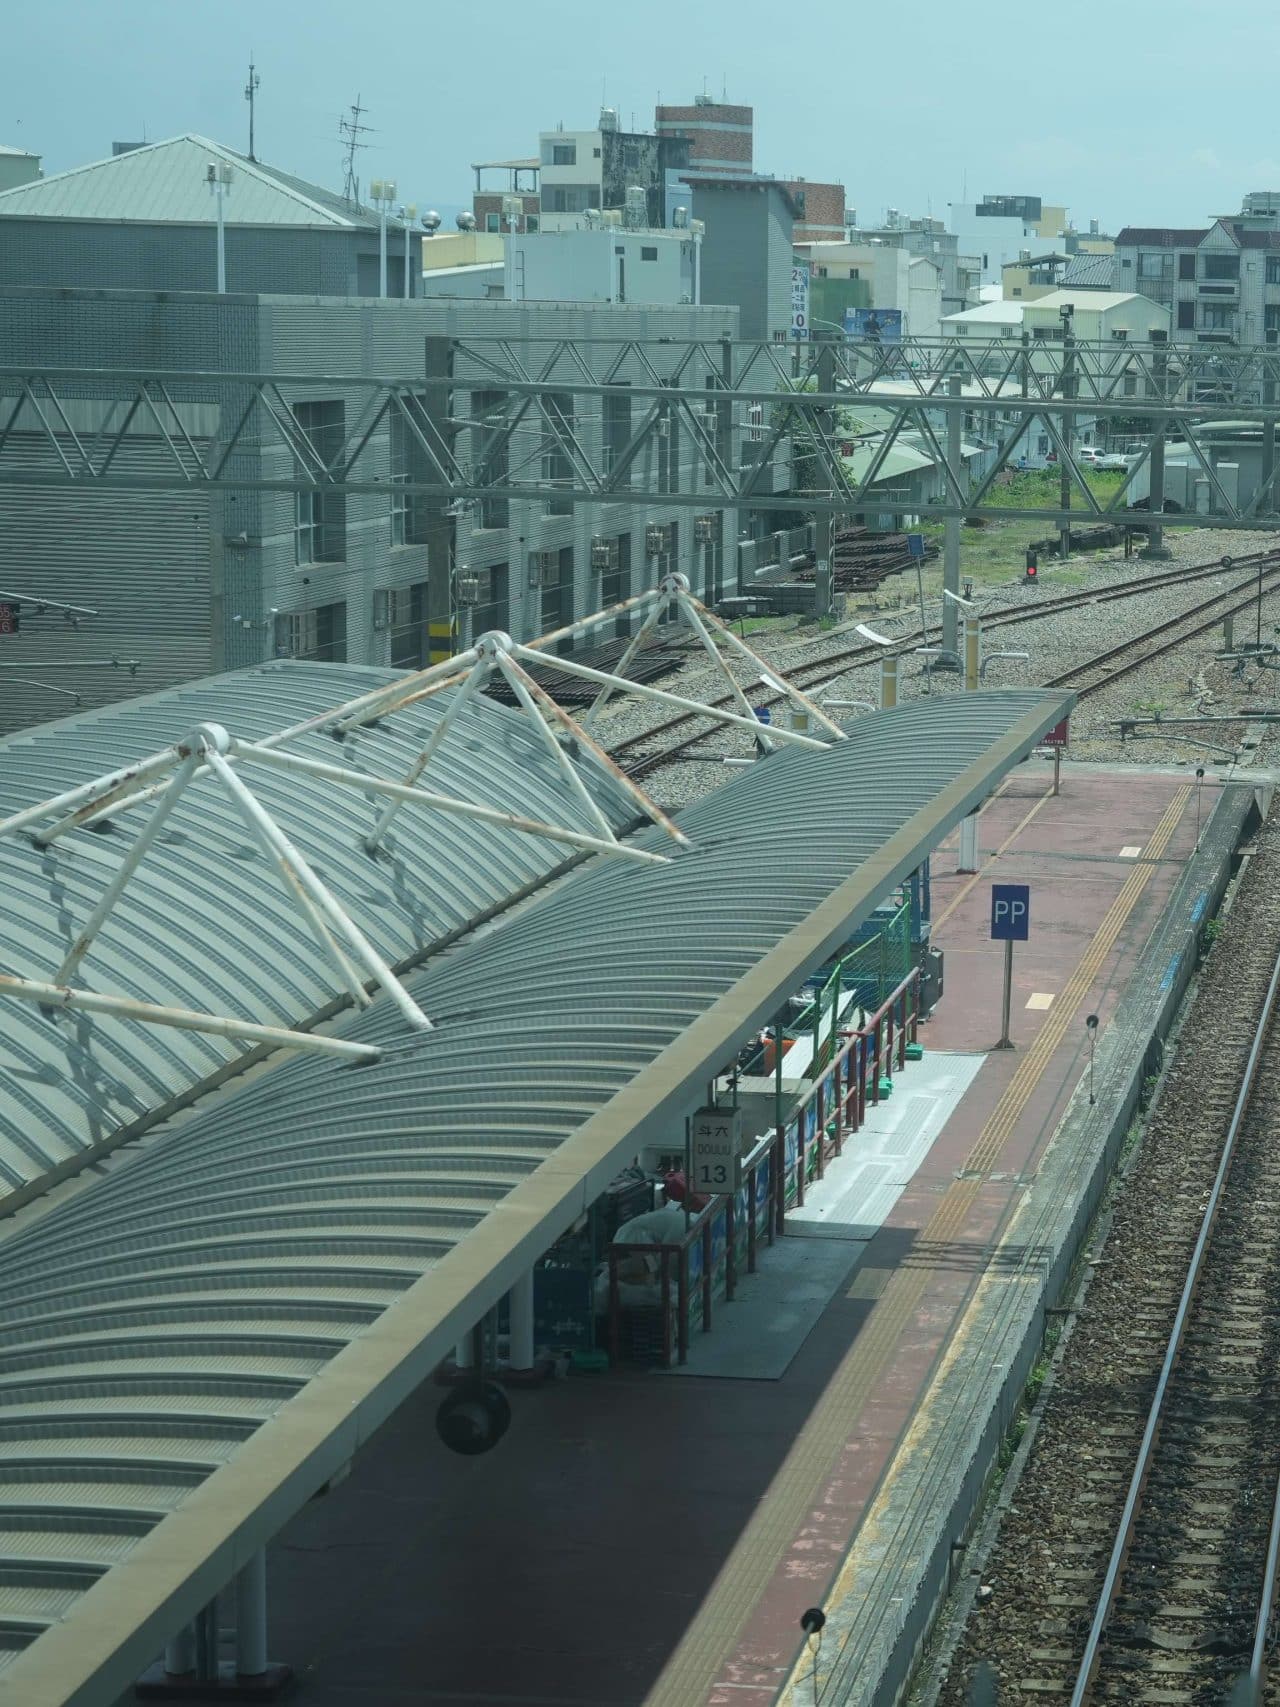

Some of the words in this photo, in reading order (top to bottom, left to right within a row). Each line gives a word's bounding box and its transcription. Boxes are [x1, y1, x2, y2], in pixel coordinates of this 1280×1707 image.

[995, 900, 1026, 924] PP
[697, 1125, 729, 1137] 斗六
[700, 1164, 727, 1184] 13
